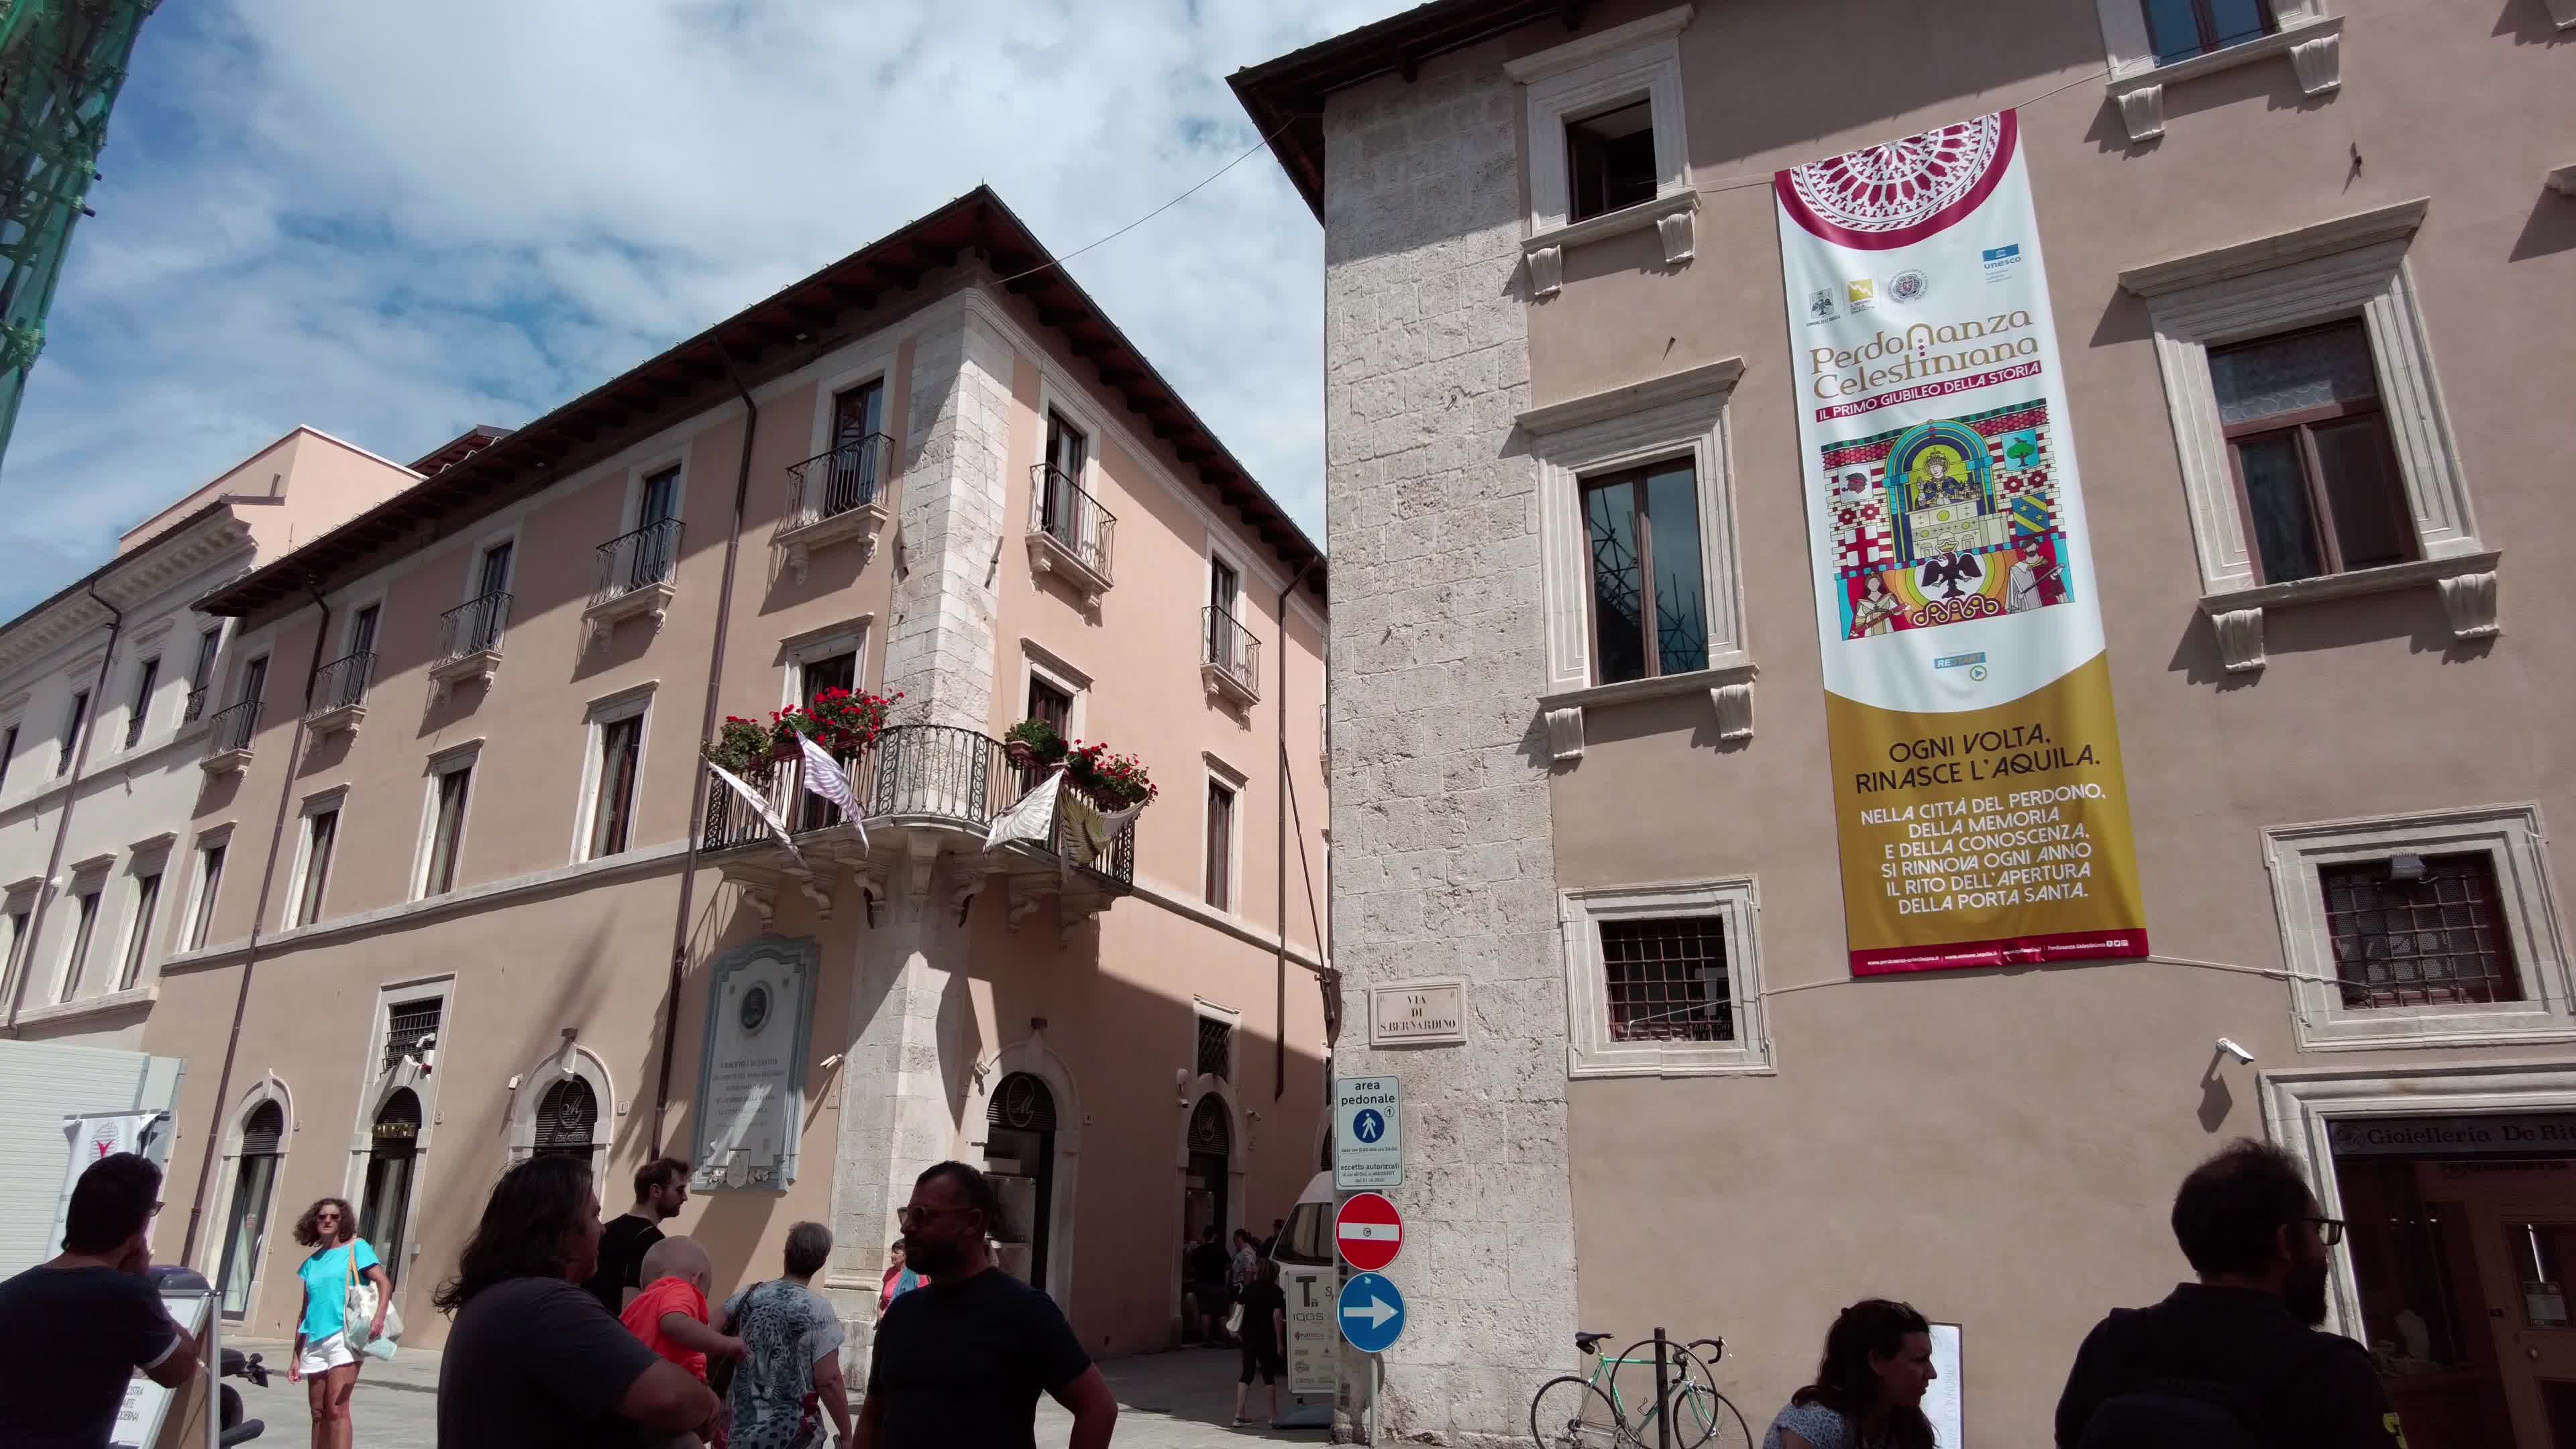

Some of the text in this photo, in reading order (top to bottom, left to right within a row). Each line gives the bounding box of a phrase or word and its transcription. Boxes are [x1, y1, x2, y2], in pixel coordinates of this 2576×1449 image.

[1984, 257, 2021, 269] unesco
[1819, 362, 2039, 421] IL PRIMO GIUBILEO DELLA STORIA
[1889, 736, 1955, 763] OGNI
[1856, 744, 2100, 794] RINASCE L'AQUILA.
[1861, 806, 1914, 825] NELLA
[1919, 797, 1966, 820] CITTÀ
[1972, 796, 2003, 814] DEL
[1909, 806, 2059, 839] DELLA MEMORIA
[1881, 842, 2092, 878] SI RINNOVA OGNI ANNO
[1885, 845, 1894, 859] E
[1900, 841, 1954, 859] DELLA
[1886, 862, 2091, 896] IL RITO DELL'APERTURA
[1898, 882, 2088, 914] DELLA PORTA SANTA.
[1407, 996, 1426, 1004] VIA
[1411, 1008, 1421, 1017] DI
[1355, 1081, 1380, 1090] area
[1342, 1093, 1395, 1106] pedonale
[2367, 1127, 2490, 1146] Gioielleria
